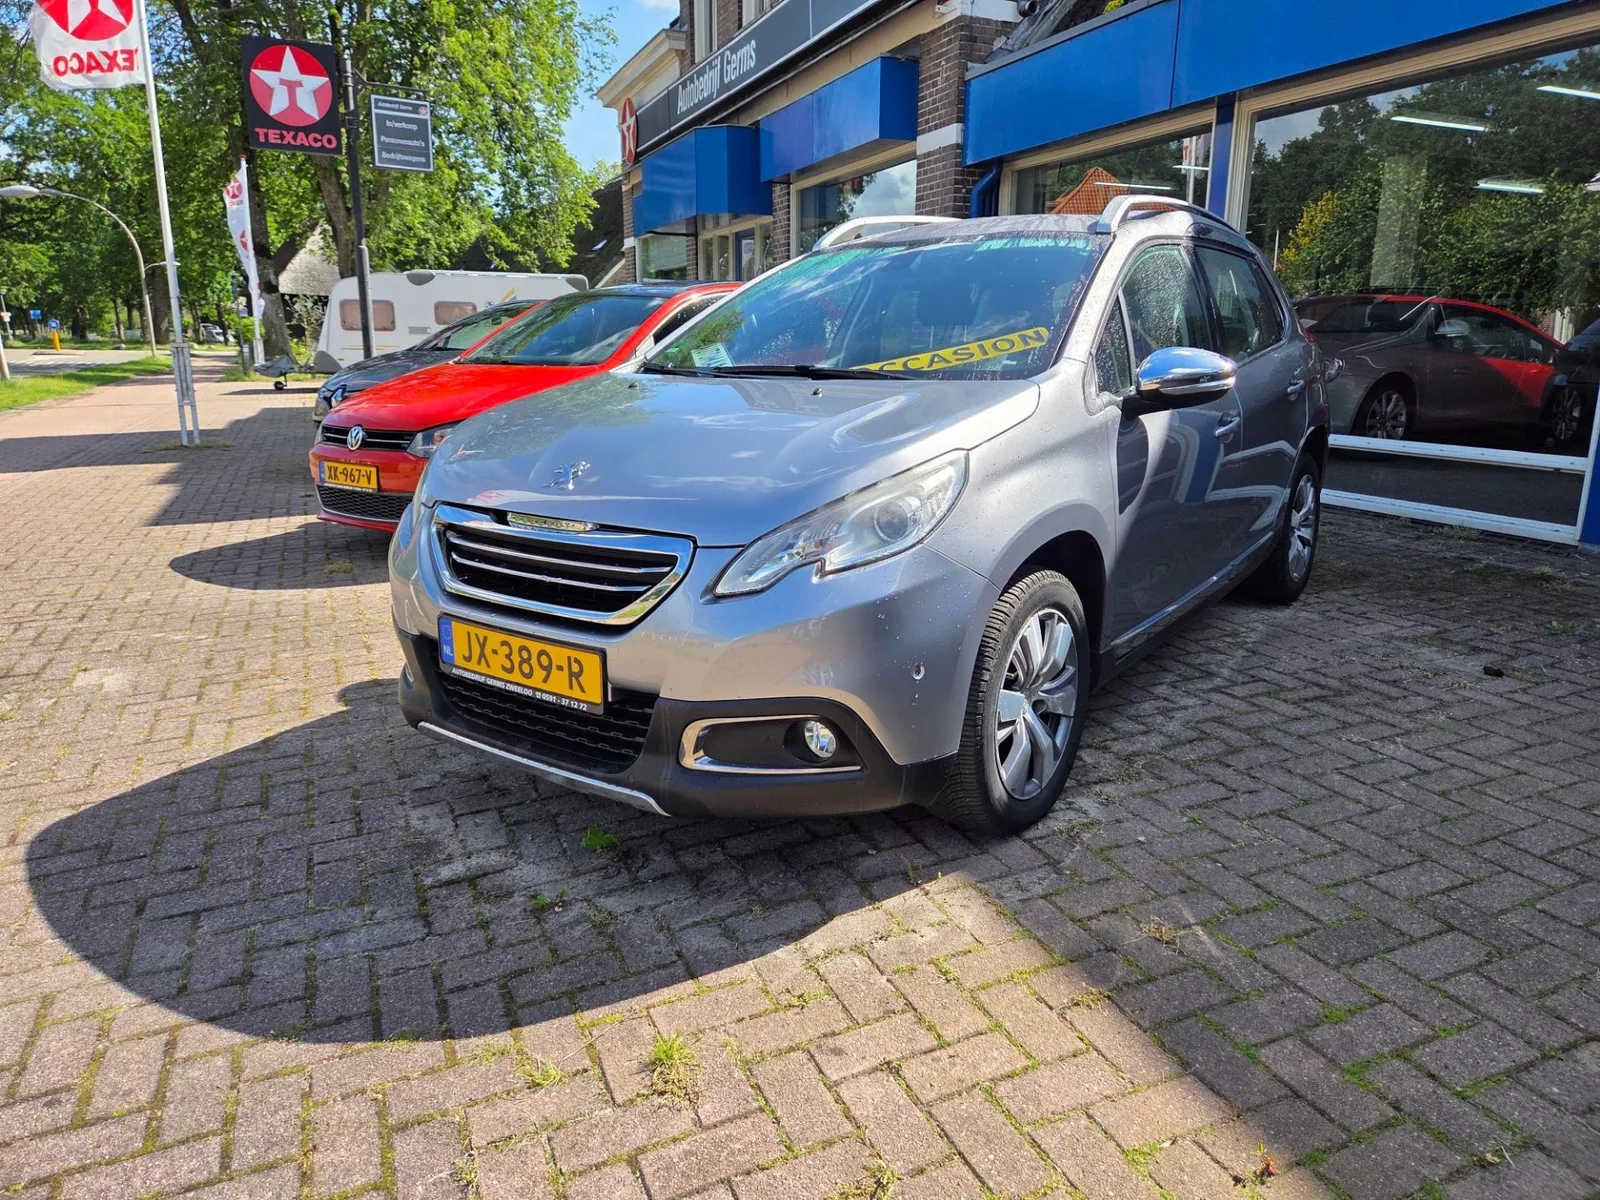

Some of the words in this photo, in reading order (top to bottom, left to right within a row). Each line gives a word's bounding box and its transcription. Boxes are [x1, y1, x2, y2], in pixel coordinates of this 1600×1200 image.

[677, 55, 720, 115] Autobedrijf
[723, 40, 756, 84] Germs
[254, 128, 337, 149] TEXACO
[858, 329, 1046, 371] CCASION
[327, 465, 372, 485] XK-967-V
[443, 644, 453, 656] NL
[462, 631, 586, 693] JX-389-R
[486, 677, 505, 688] GERMS
[506, 683, 533, 696] ZWEELOO
[579, 702, 587, 711] 72
